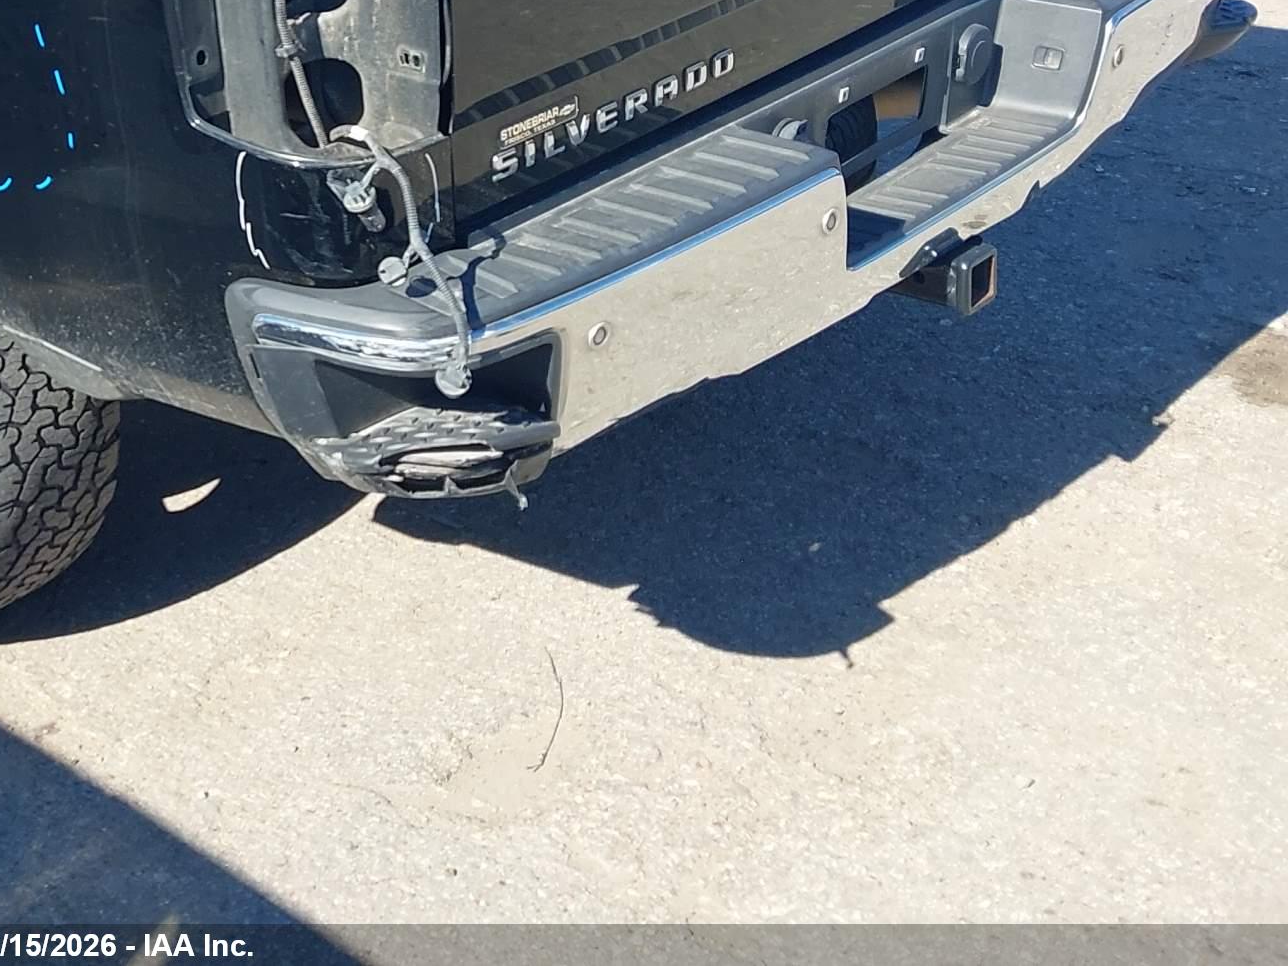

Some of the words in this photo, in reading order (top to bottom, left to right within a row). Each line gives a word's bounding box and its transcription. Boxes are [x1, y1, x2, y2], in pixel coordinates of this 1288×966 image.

[492, 48, 735, 183] SILVERADO
[500, 106, 560, 141] STONEBRIAR
[533, 119, 557, 133] TEXAS
